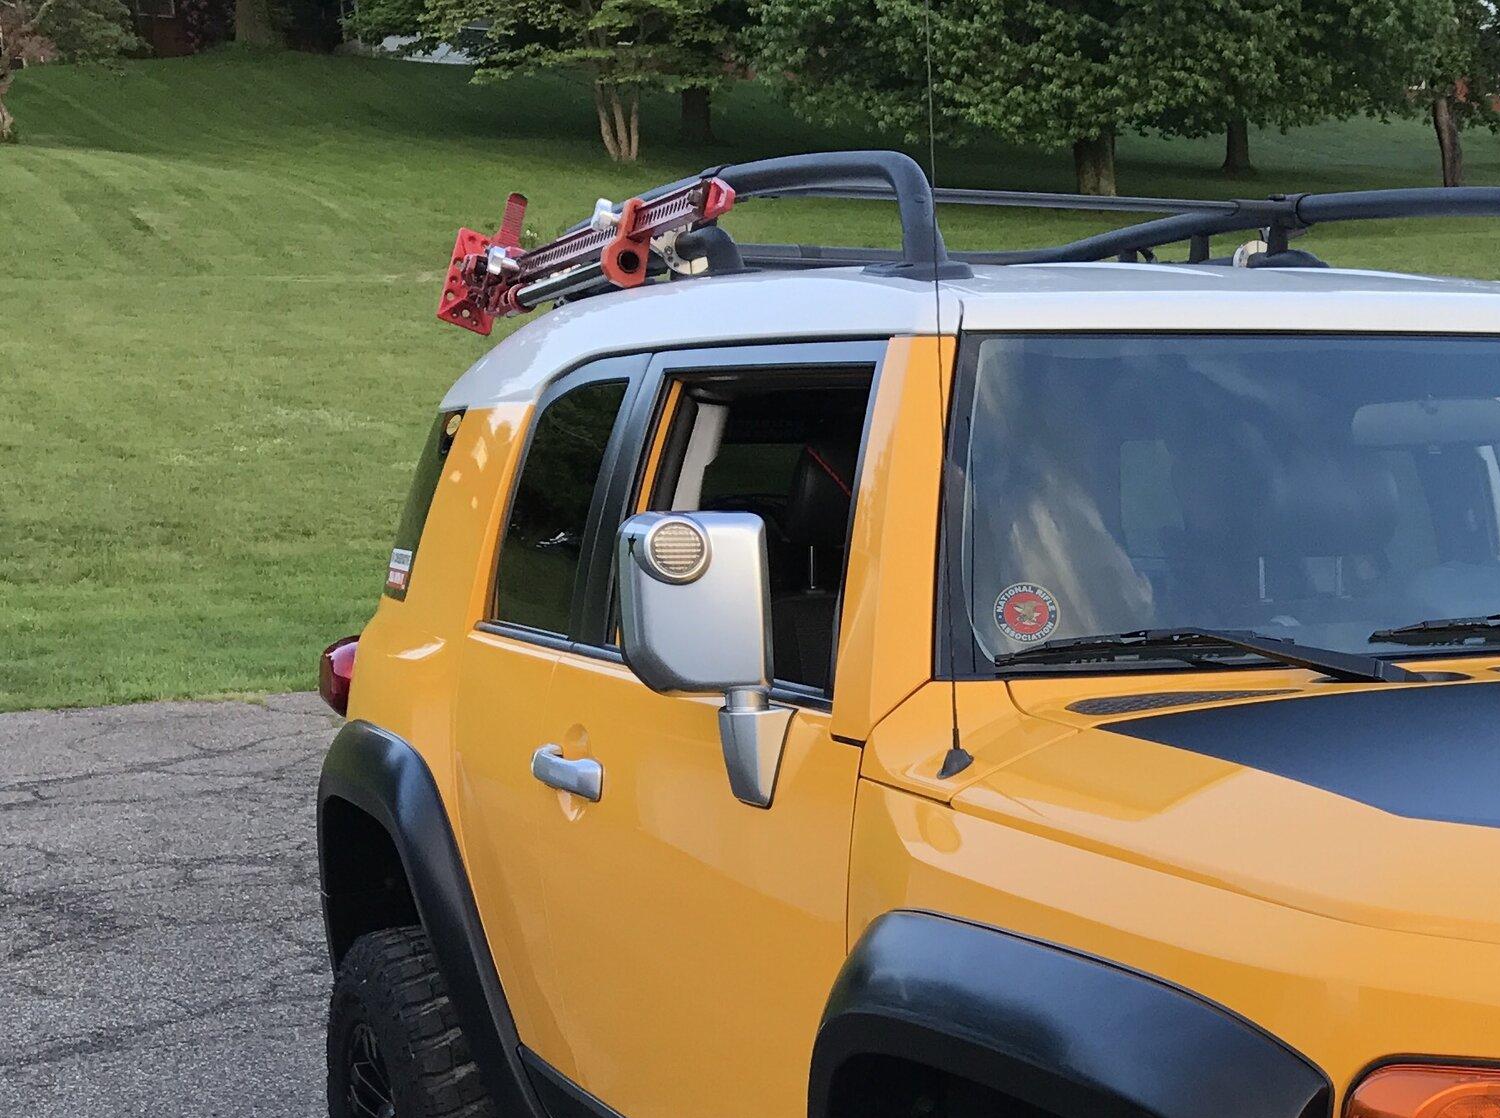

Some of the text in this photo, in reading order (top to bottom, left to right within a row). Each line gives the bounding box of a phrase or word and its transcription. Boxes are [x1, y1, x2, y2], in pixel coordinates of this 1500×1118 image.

[996, 585, 1056, 613] NATIONAL RIFLE
[1000, 621, 1054, 641] ASSOCIATION
